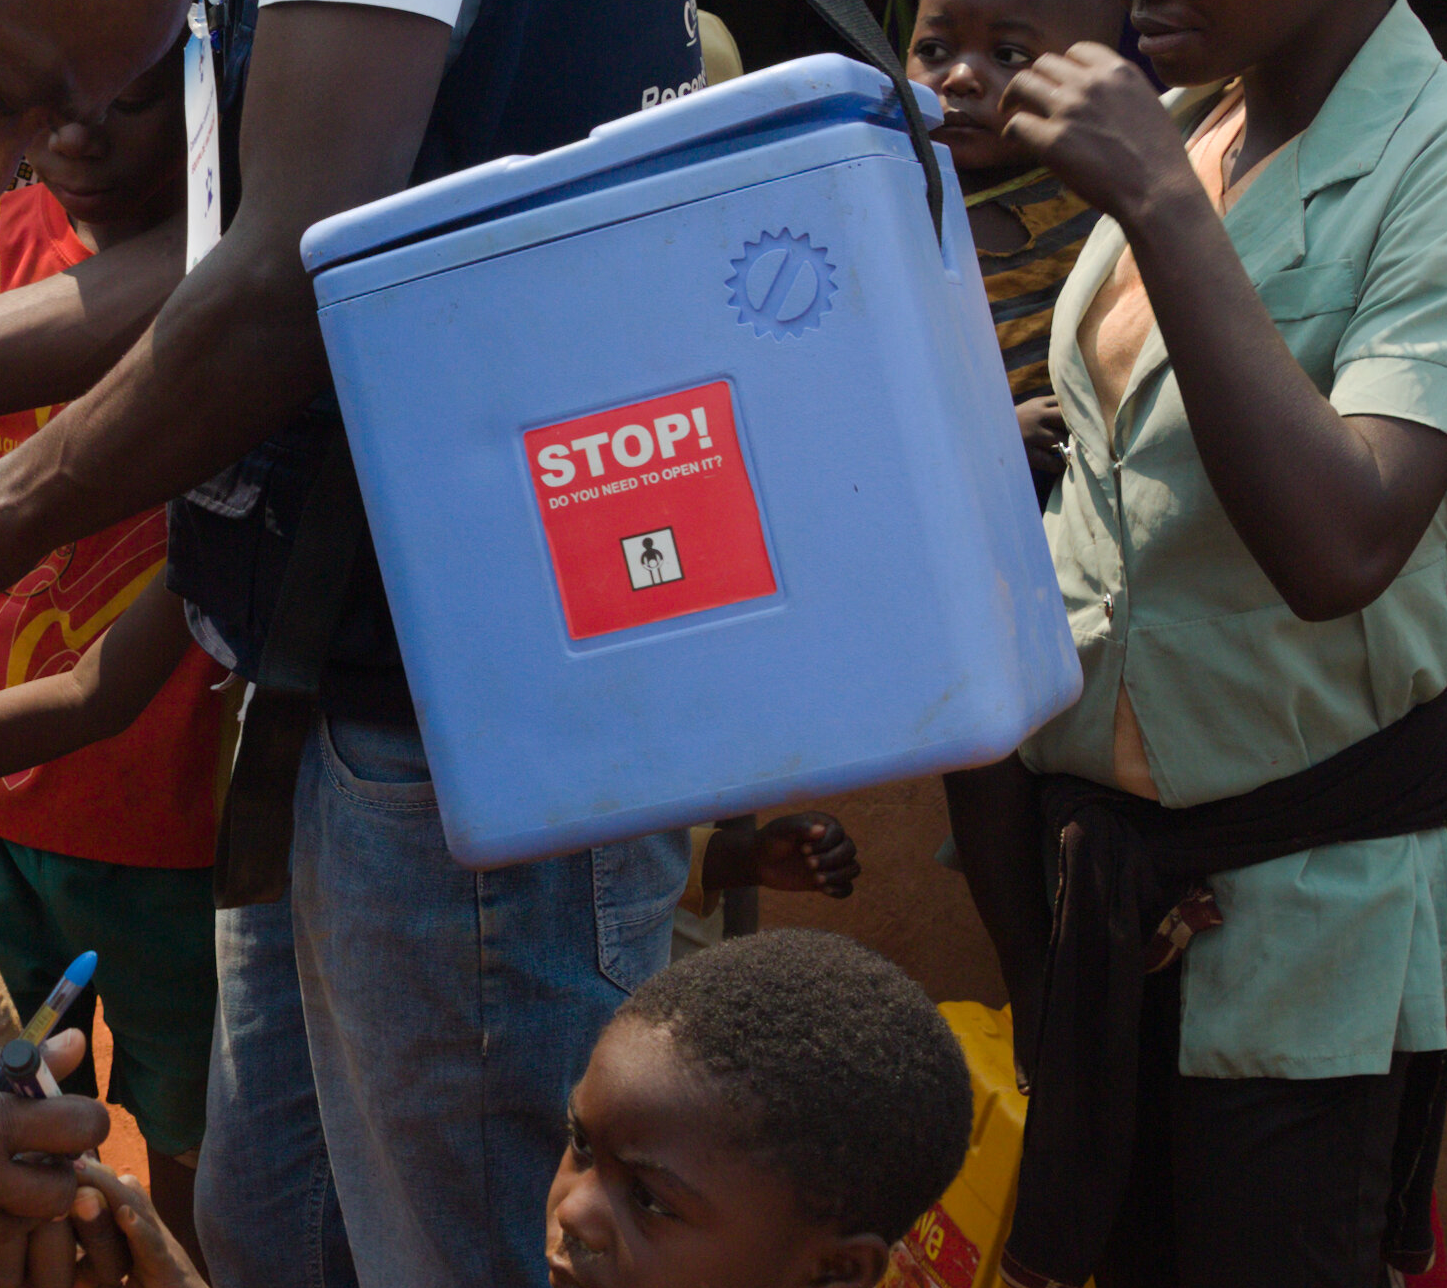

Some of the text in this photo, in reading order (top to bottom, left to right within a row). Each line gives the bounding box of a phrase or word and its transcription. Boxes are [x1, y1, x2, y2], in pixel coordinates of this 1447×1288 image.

[537, 407, 713, 488] STOP!
[549, 455, 722, 510] DO YOU NEED TO OPEN IT?
